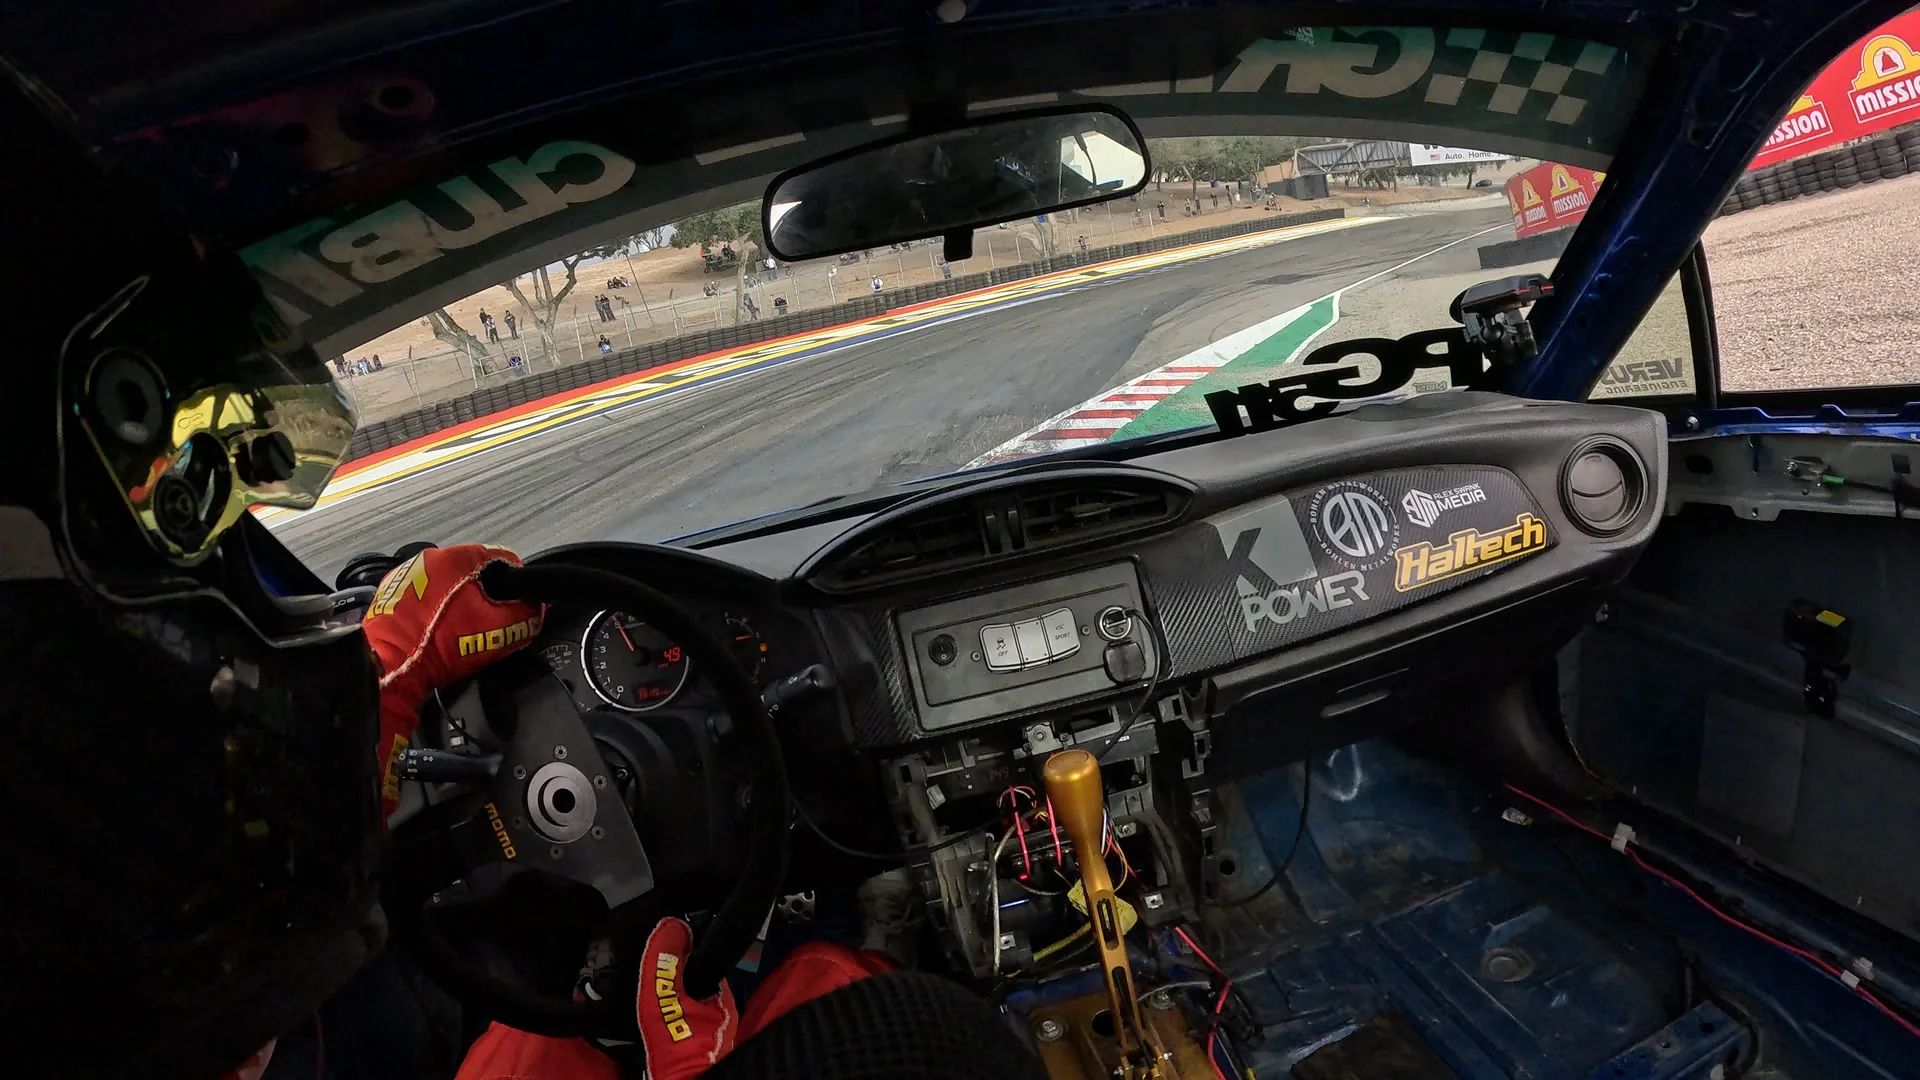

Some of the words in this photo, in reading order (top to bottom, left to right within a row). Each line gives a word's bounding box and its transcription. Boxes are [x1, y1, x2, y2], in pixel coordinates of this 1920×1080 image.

[1468, 151, 1494, 159] Home.
[1310, 488, 1327, 524] BOHLEN
[1437, 489, 1487, 512] MEDIA
[1320, 542, 1356, 570] BOHLEN
[1360, 524, 1400, 572] METALWORKS
[1400, 517, 1544, 586] Haltech
[1240, 570, 1370, 633] POWER
[1054, 632, 1070, 640] SPORT
[599, 646, 607, 654] 3
[663, 646, 681, 662] 49
[616, 685, 624, 693] 0
